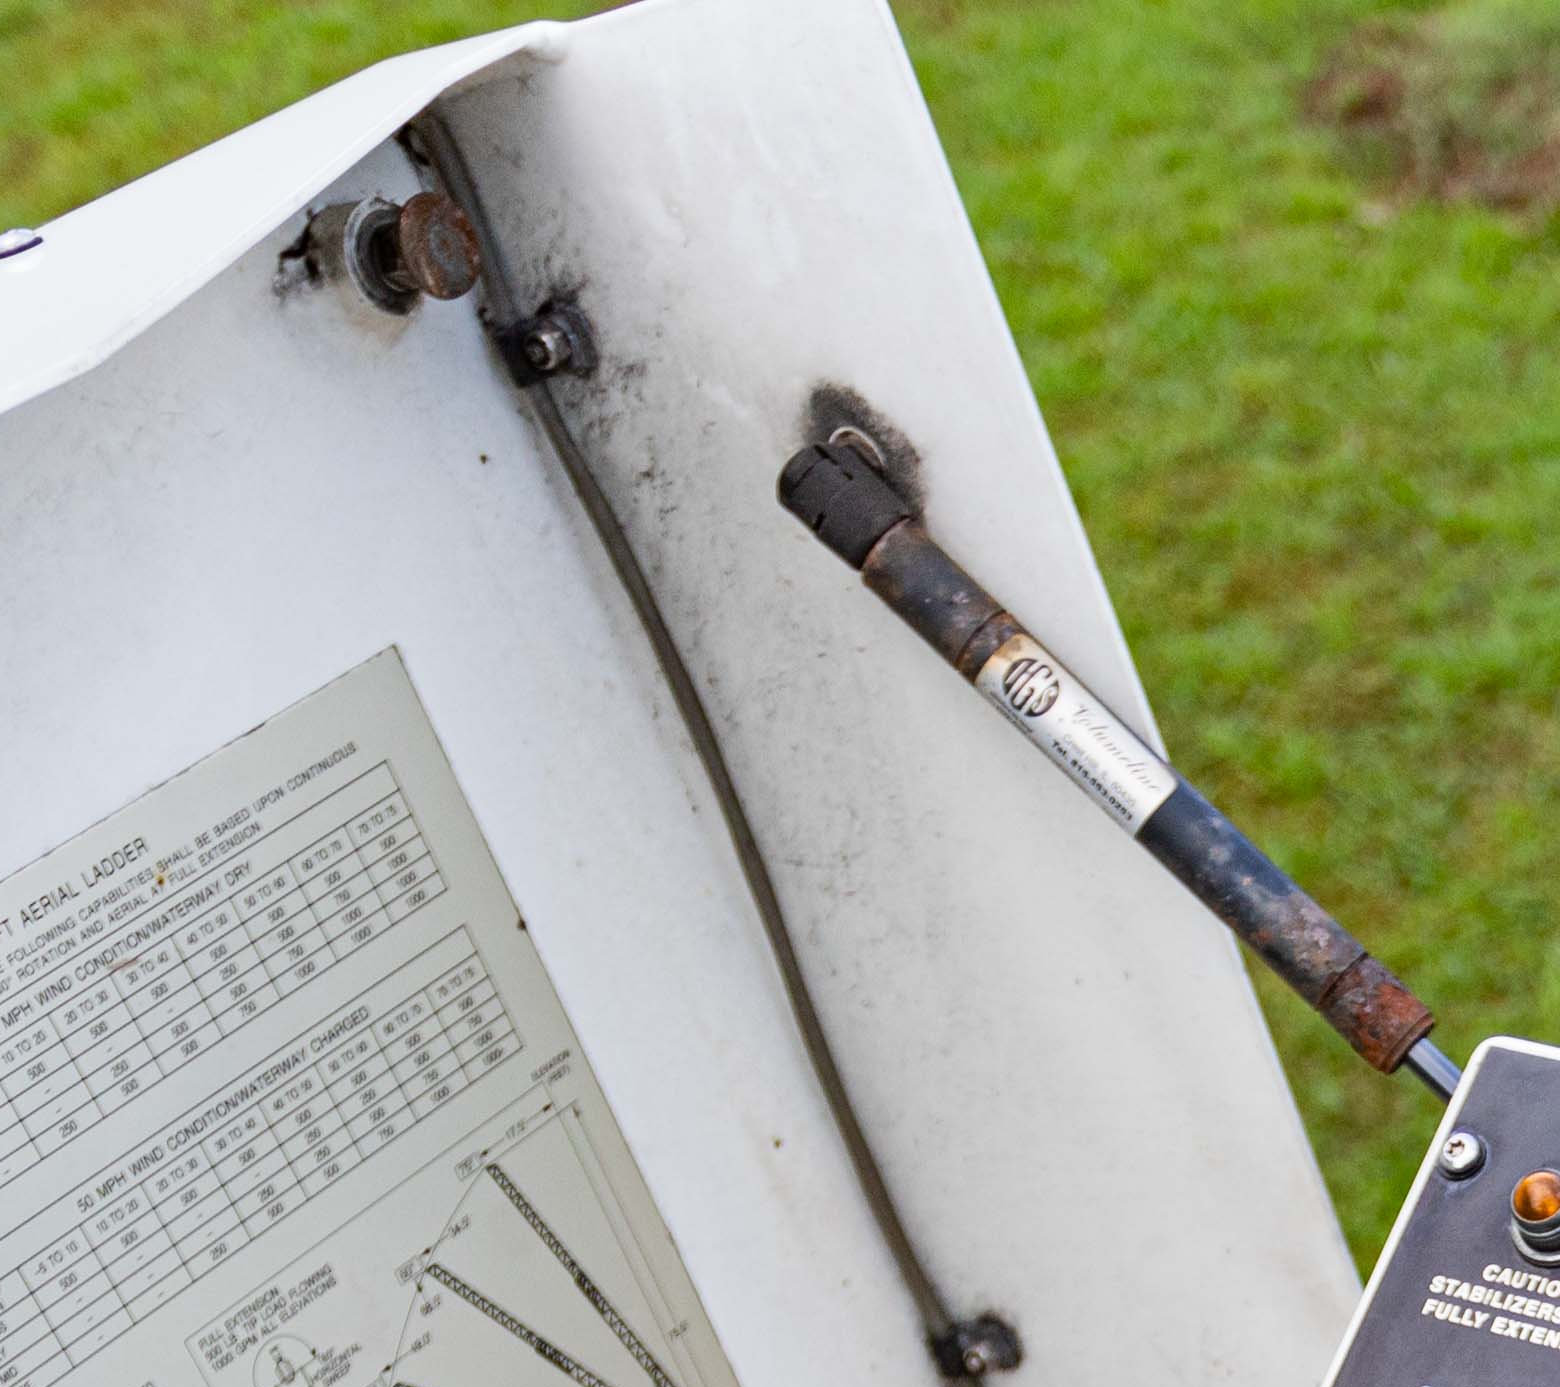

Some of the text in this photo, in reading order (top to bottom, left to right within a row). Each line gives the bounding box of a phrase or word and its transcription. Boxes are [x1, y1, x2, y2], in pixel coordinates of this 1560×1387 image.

[19, 883, 80, 927] AERIAL
[81, 836, 148, 888] LADDER
[0, 1000, 33, 1027] MPH
[33, 975, 72, 1006] WIND
[223, 860, 250, 887] DRY
[5, 915, 76, 964] FOLLOWING
[94, 1171, 127, 1198] MPH
[127, 1145, 164, 1176] WIND
[309, 1005, 369, 1053] CHARGED
[1421, 1297, 1489, 1328] FULLY
